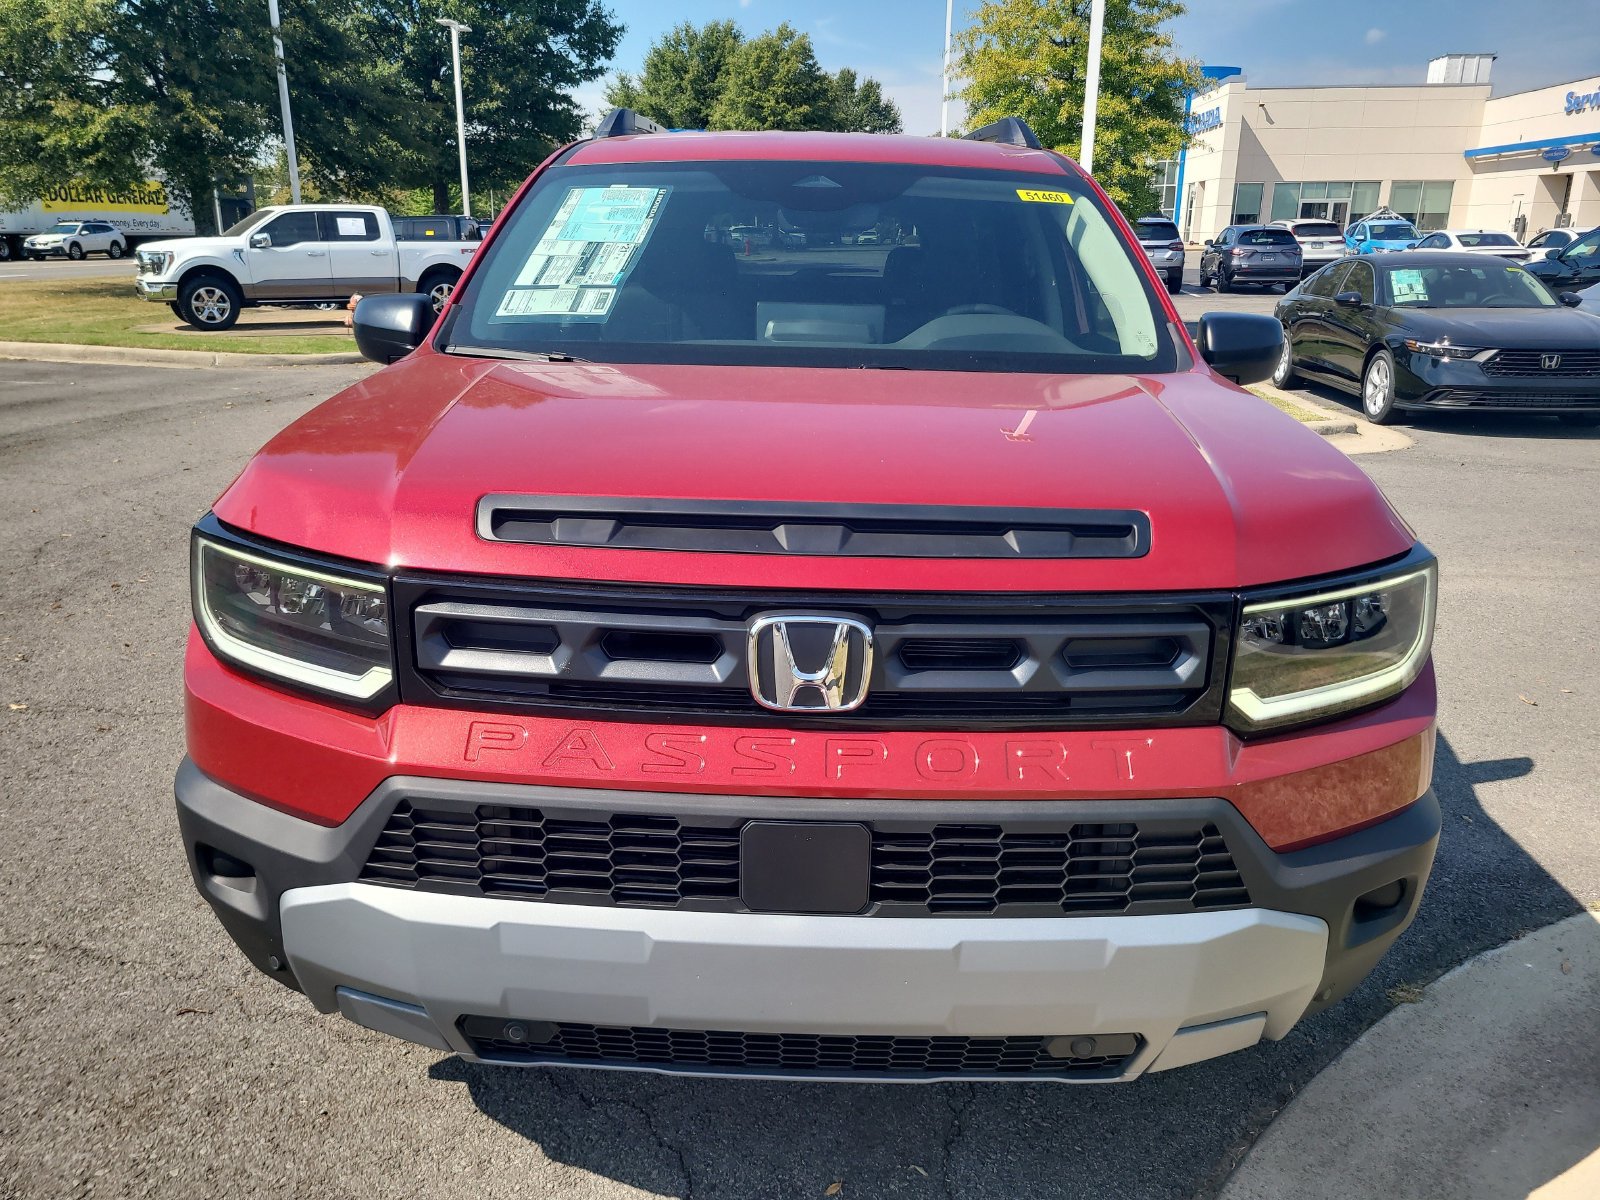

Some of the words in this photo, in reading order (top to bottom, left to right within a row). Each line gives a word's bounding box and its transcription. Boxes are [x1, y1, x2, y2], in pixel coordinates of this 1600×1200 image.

[1025, 191, 1064, 203] 51460
[132, 219, 149, 229] Every
[464, 720, 1155, 782] PASSPORT
